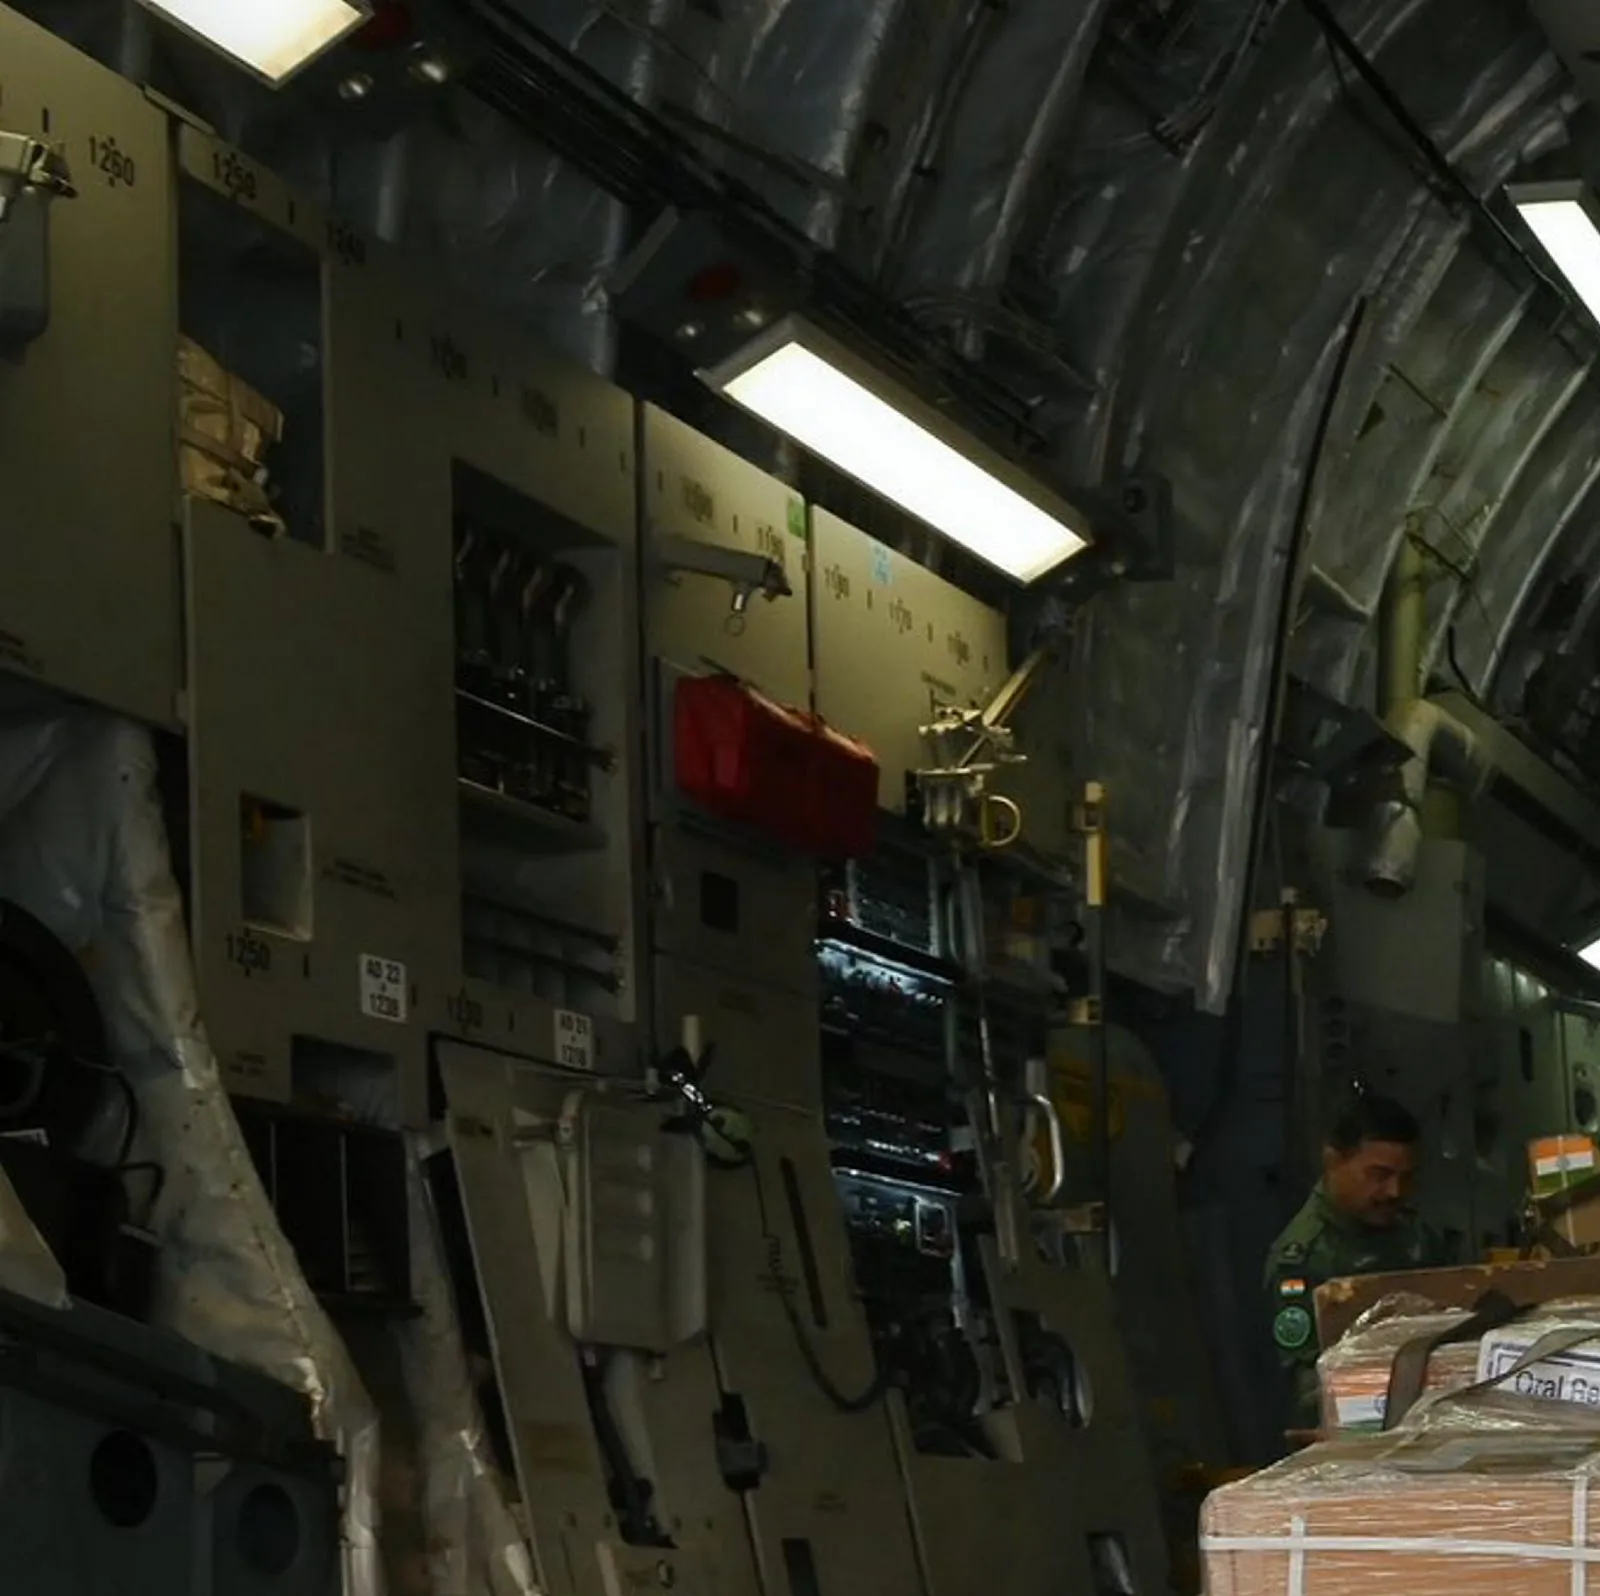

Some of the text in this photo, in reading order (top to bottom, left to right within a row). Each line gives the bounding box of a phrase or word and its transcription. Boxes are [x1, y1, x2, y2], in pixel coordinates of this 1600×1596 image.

[89, 136, 135, 187] 1260
[212, 152, 257, 200] 1250
[226, 932, 270, 973] 1250
[1515, 1370, 1564, 1399] Oral
